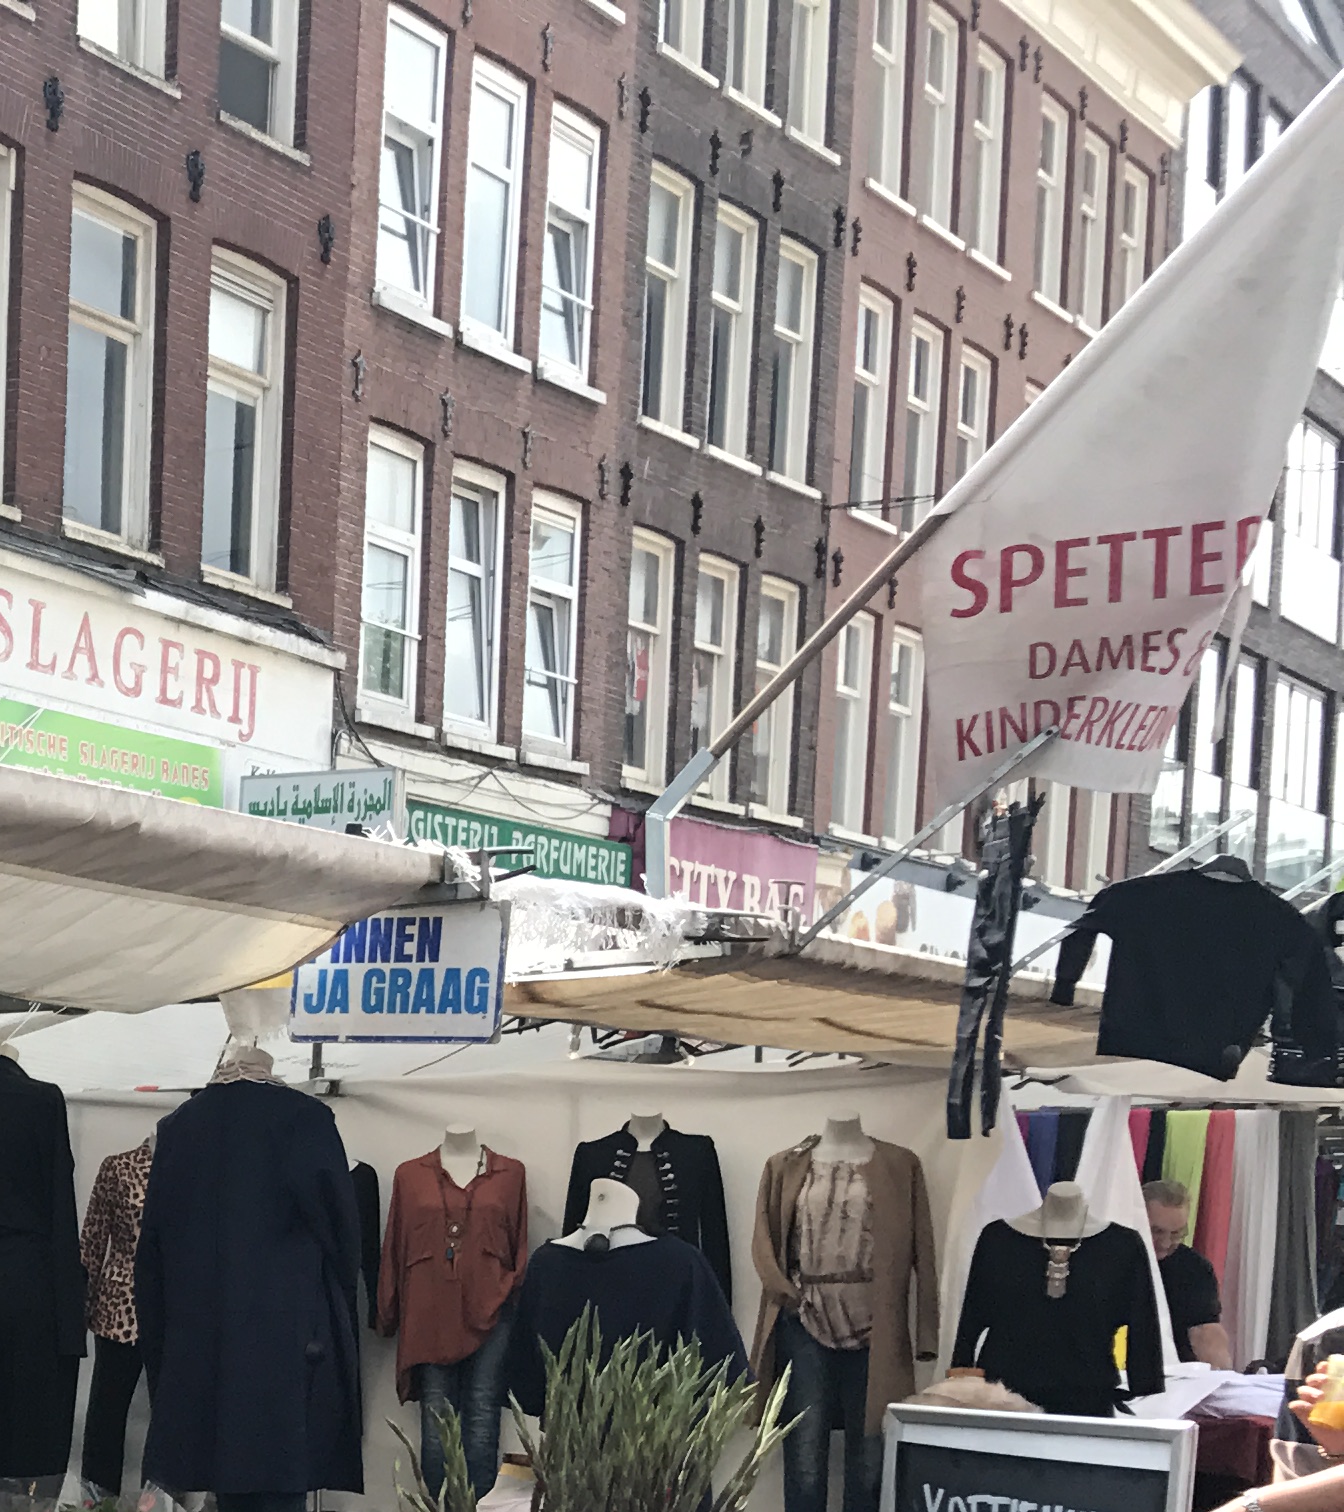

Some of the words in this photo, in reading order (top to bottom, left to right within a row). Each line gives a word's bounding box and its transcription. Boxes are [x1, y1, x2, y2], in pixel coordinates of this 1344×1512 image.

[1028, 627, 1188, 681] DAMES
[79, 741, 156, 778] SLAGERIJ
[310, 916, 443, 964] INNEN
[303, 968, 350, 1014] JA
[361, 967, 491, 1015] GRAAG
